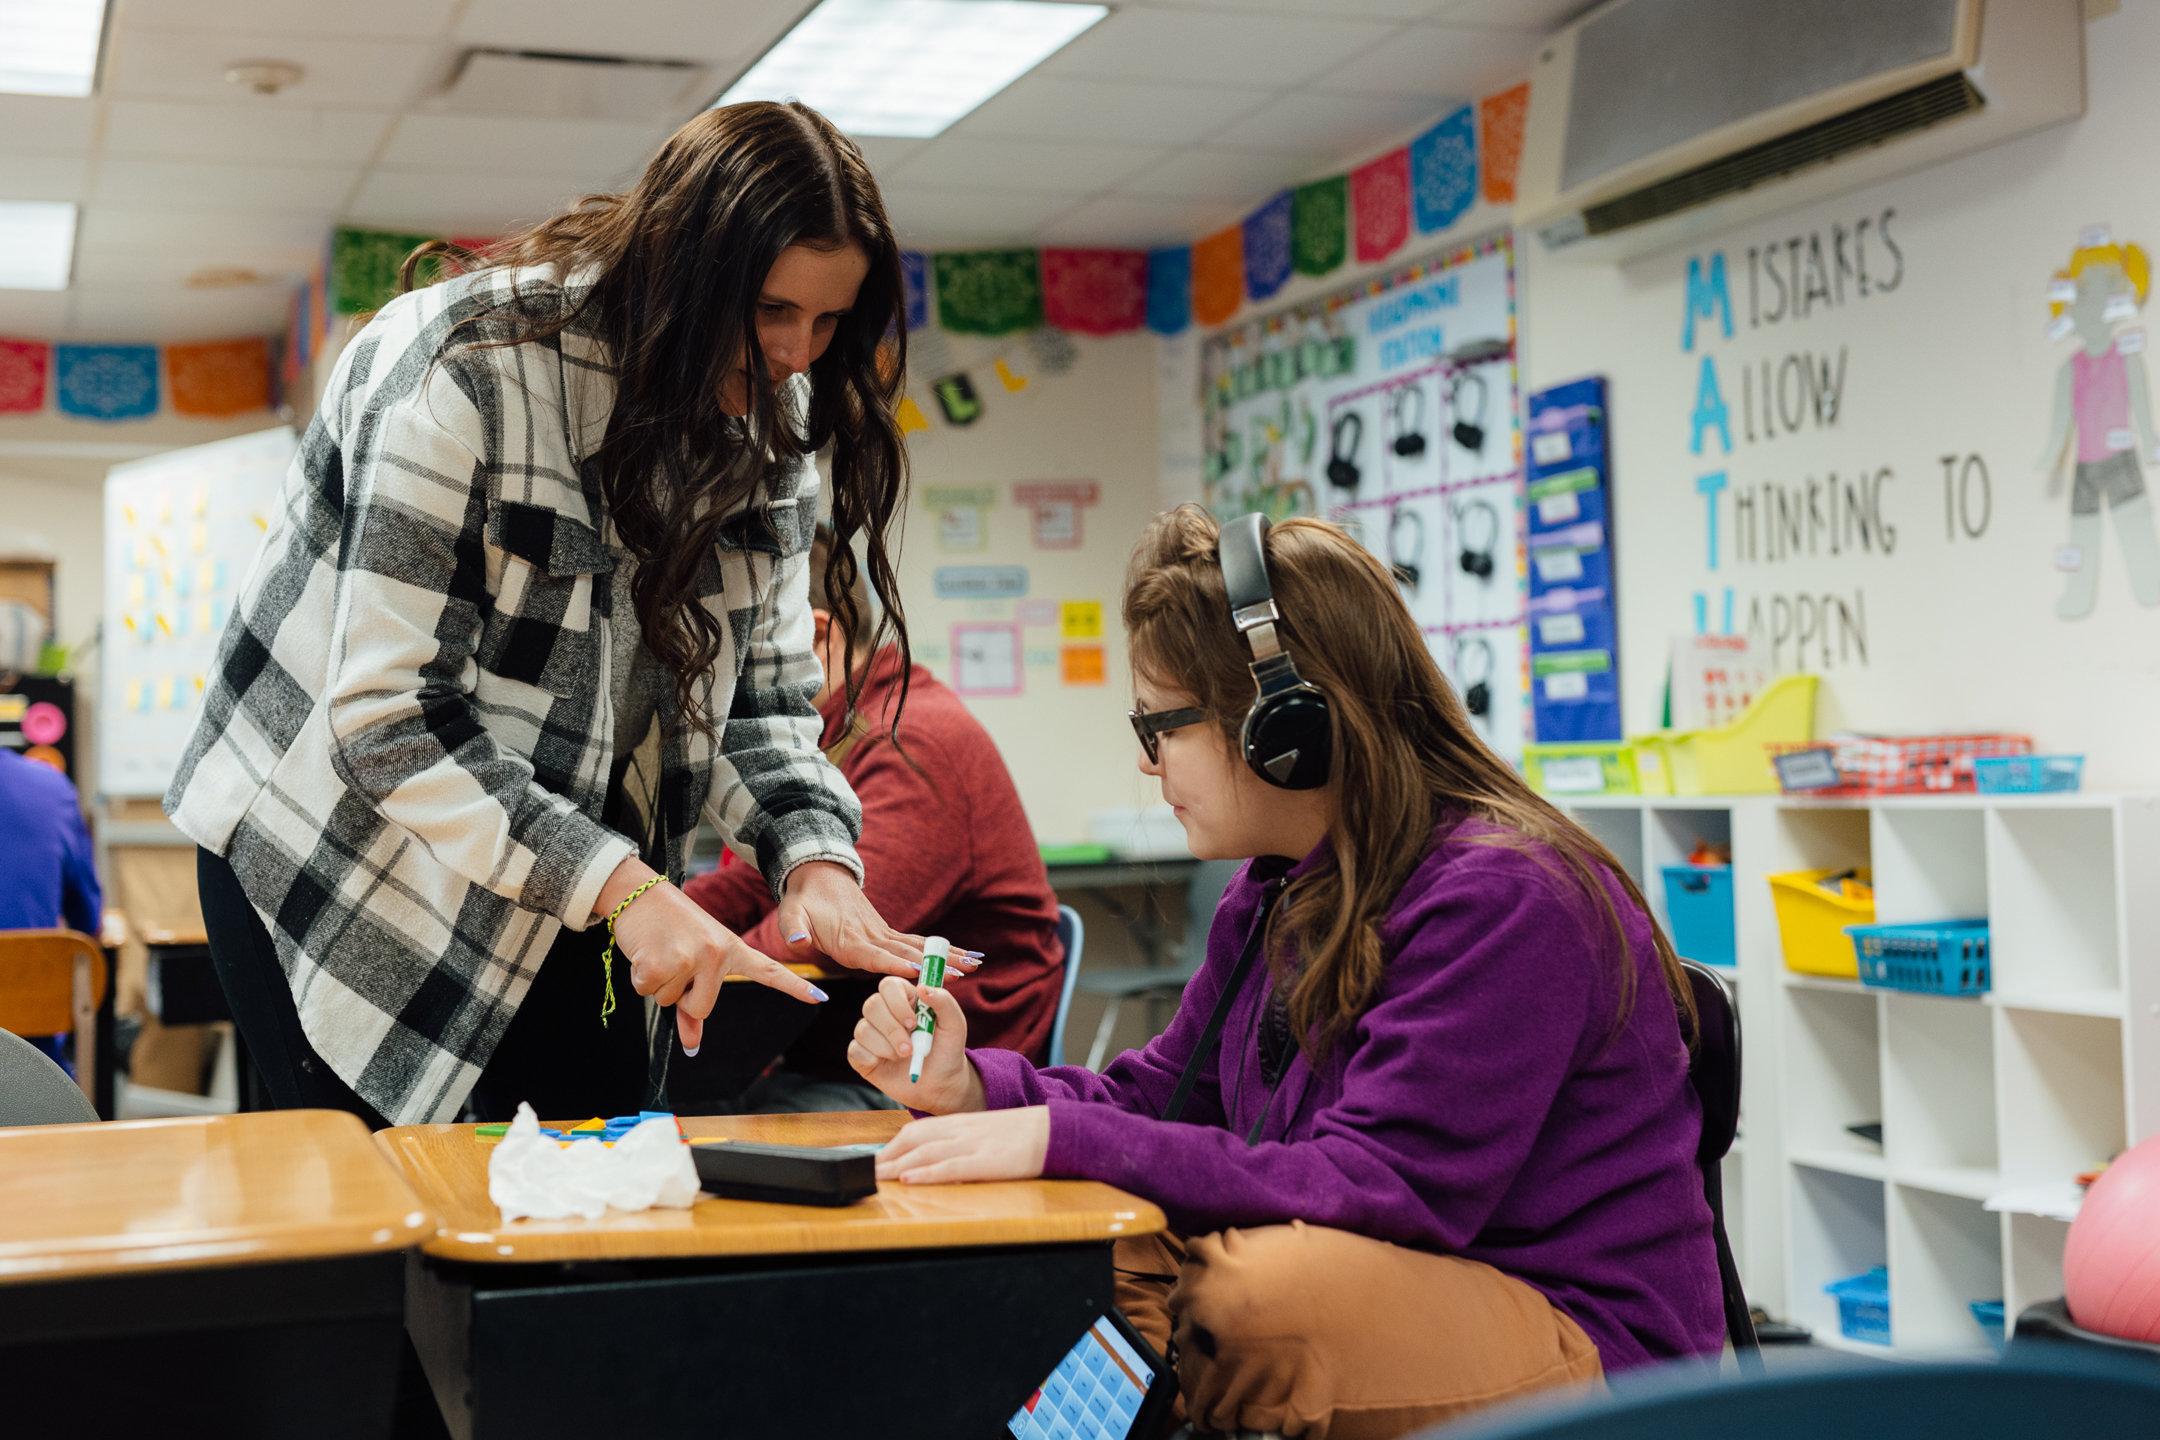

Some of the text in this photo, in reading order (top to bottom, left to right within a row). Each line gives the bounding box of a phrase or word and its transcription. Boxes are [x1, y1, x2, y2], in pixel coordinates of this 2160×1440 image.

[1681, 207, 1904, 353] MISTAKES
[1689, 346, 1849, 455] ALLOW
[1695, 452, 1992, 571] THINKING TO
